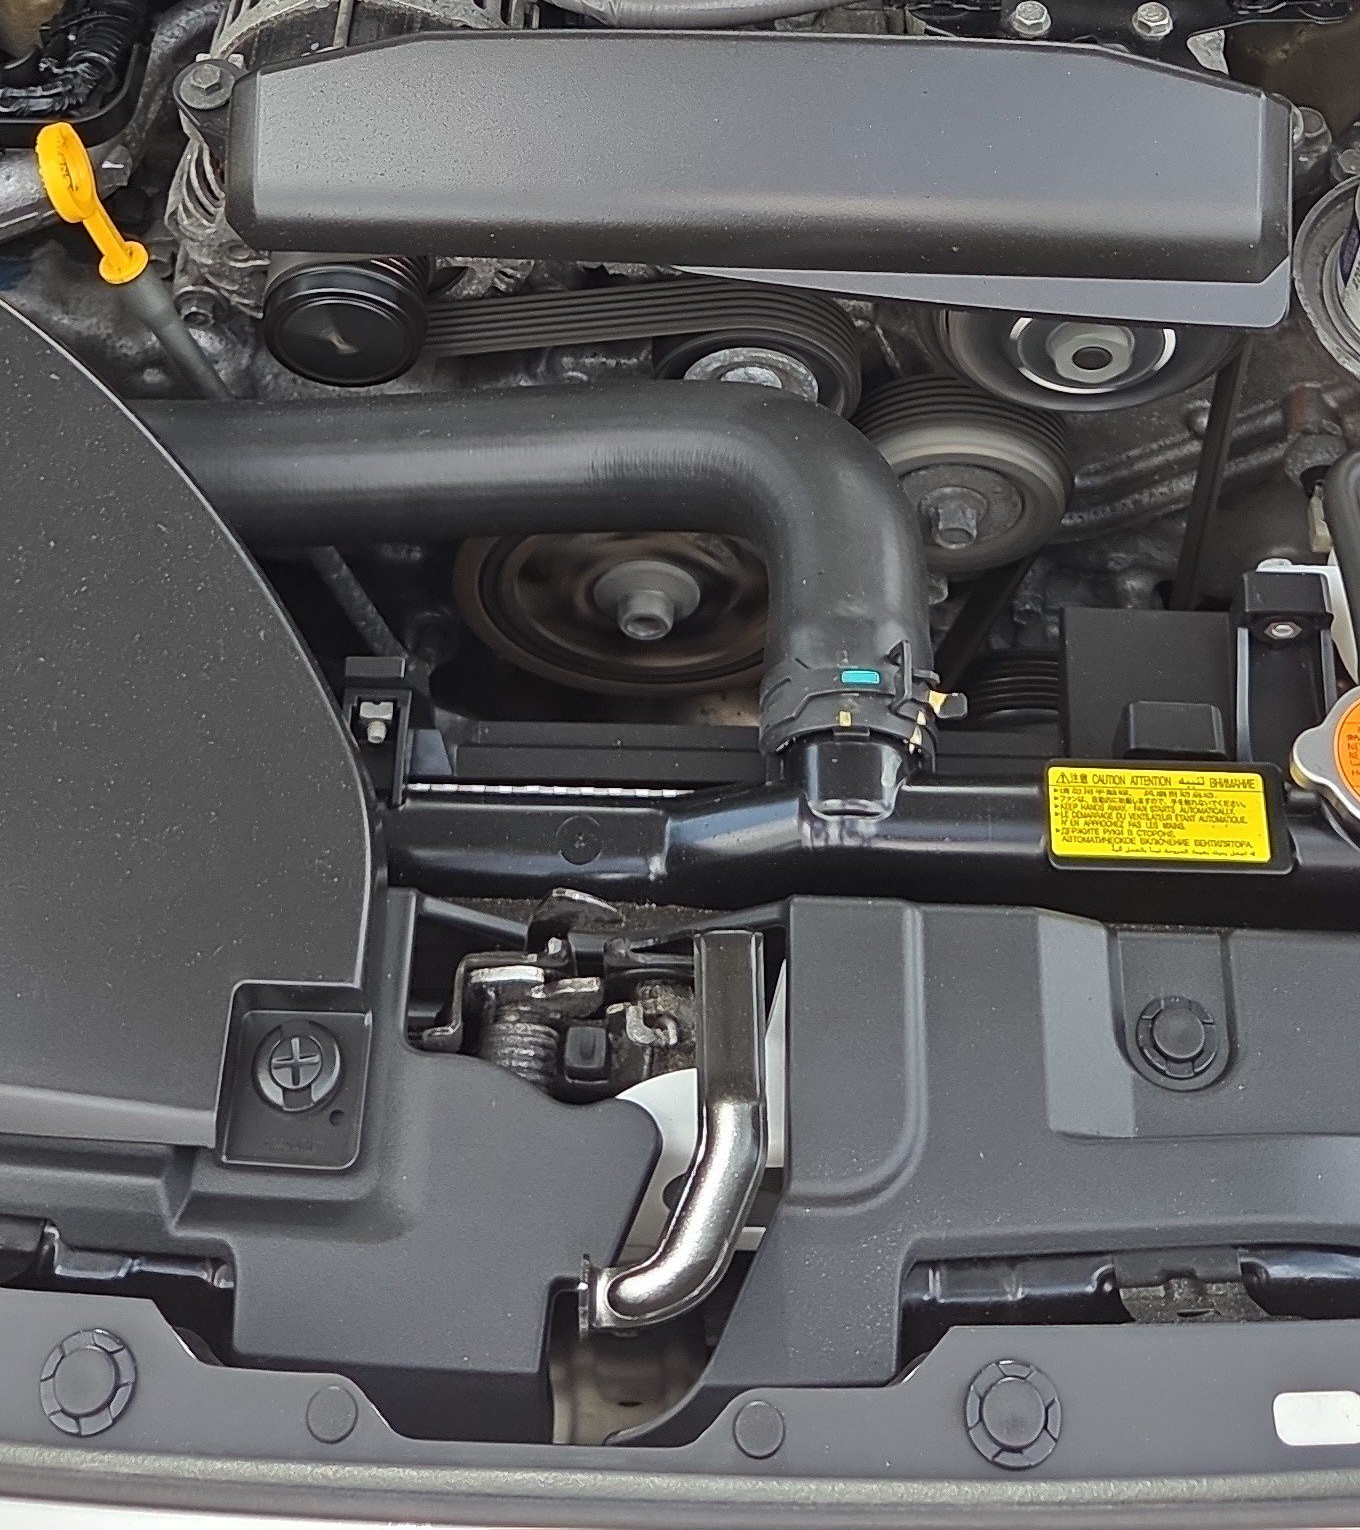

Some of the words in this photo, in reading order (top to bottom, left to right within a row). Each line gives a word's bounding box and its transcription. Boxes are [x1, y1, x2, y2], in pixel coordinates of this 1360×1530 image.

[1092, 774, 1125, 786] CAUTION
[1130, 775, 1171, 787] ATTENTION
[1210, 778, 1255, 789] ВНИМАНИЕ
[1150, 805, 1175, 813] STARTS
[1129, 813, 1172, 822] VENTILATEUR
[1083, 820, 1123, 829] APPROCHEZ
